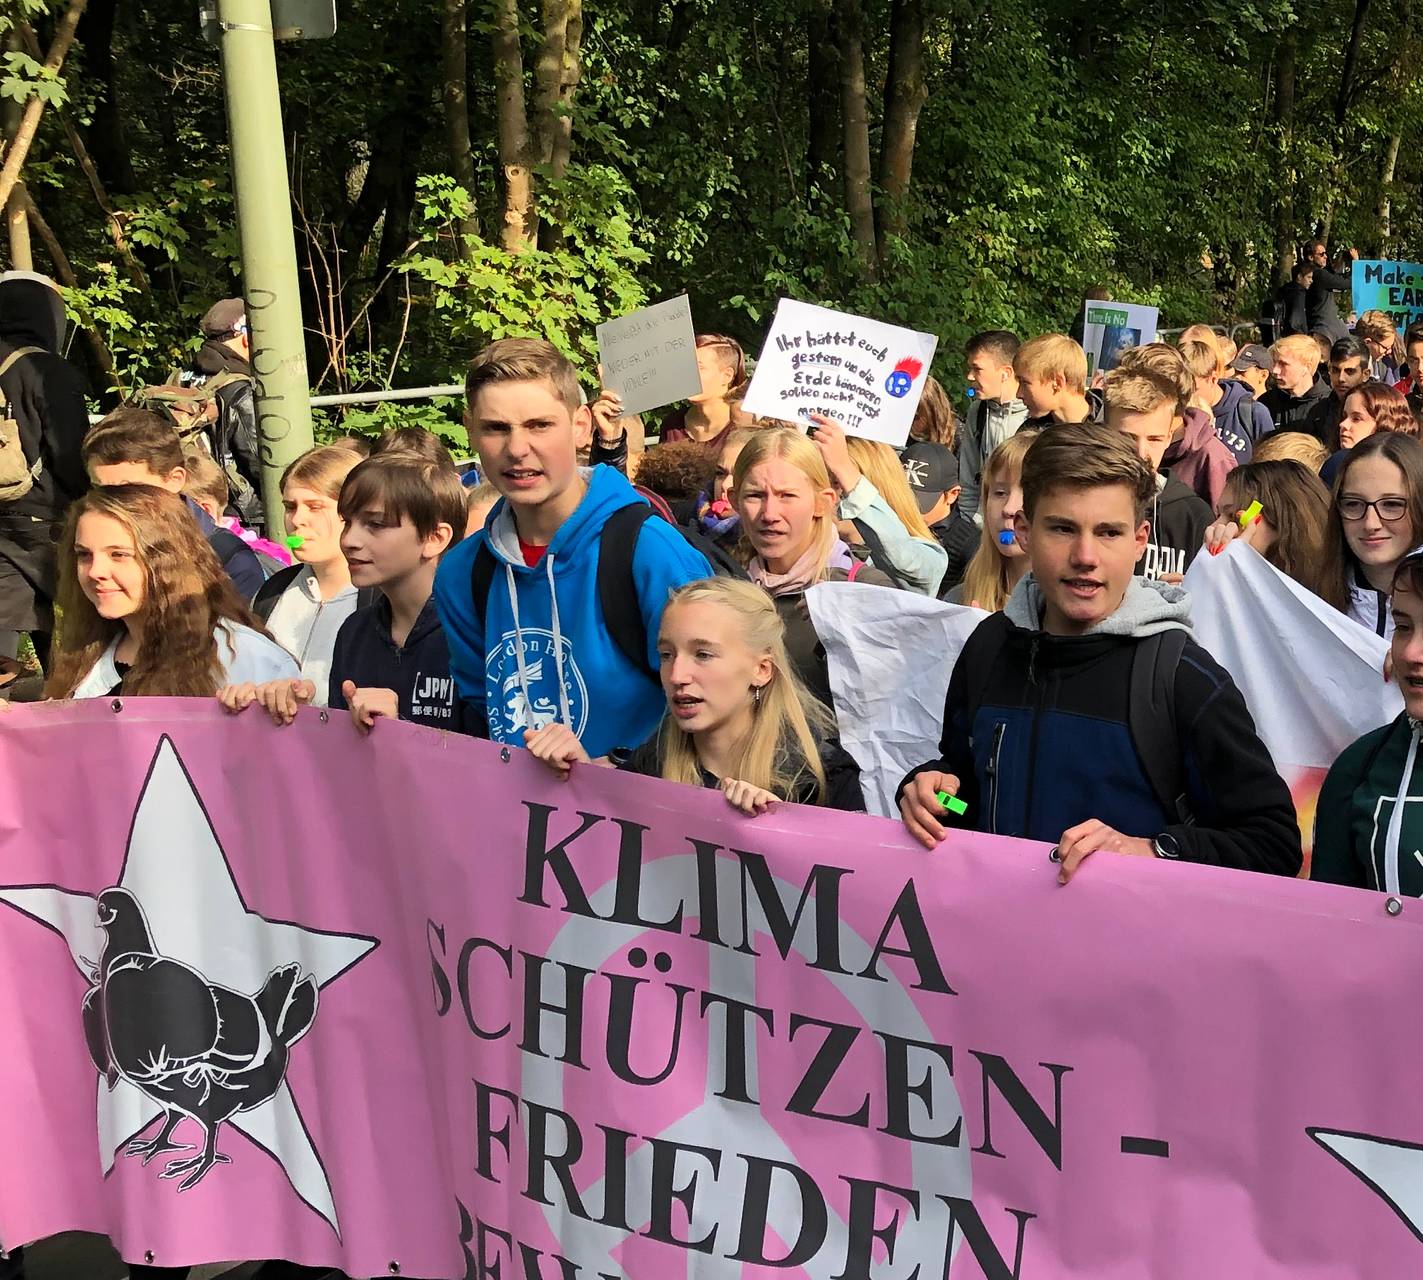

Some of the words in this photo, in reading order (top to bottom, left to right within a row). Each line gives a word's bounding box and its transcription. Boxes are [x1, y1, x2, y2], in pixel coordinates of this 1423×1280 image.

[1365, 264, 1414, 286] Make
[775, 334, 802, 352] Ihr
[806, 330, 856, 347] hättet
[858, 339, 889, 362] euch
[794, 371, 832, 385] Erde
[859, 368, 875, 386] die
[780, 386, 819, 400] sollen
[823, 391, 854, 403] nicht
[857, 401, 881, 419] erst
[516, 800, 958, 996] KLIMA
[427, 917, 1075, 1172] SCHÜTZEN
[473, 1078, 1038, 1280] FRIEDEN
